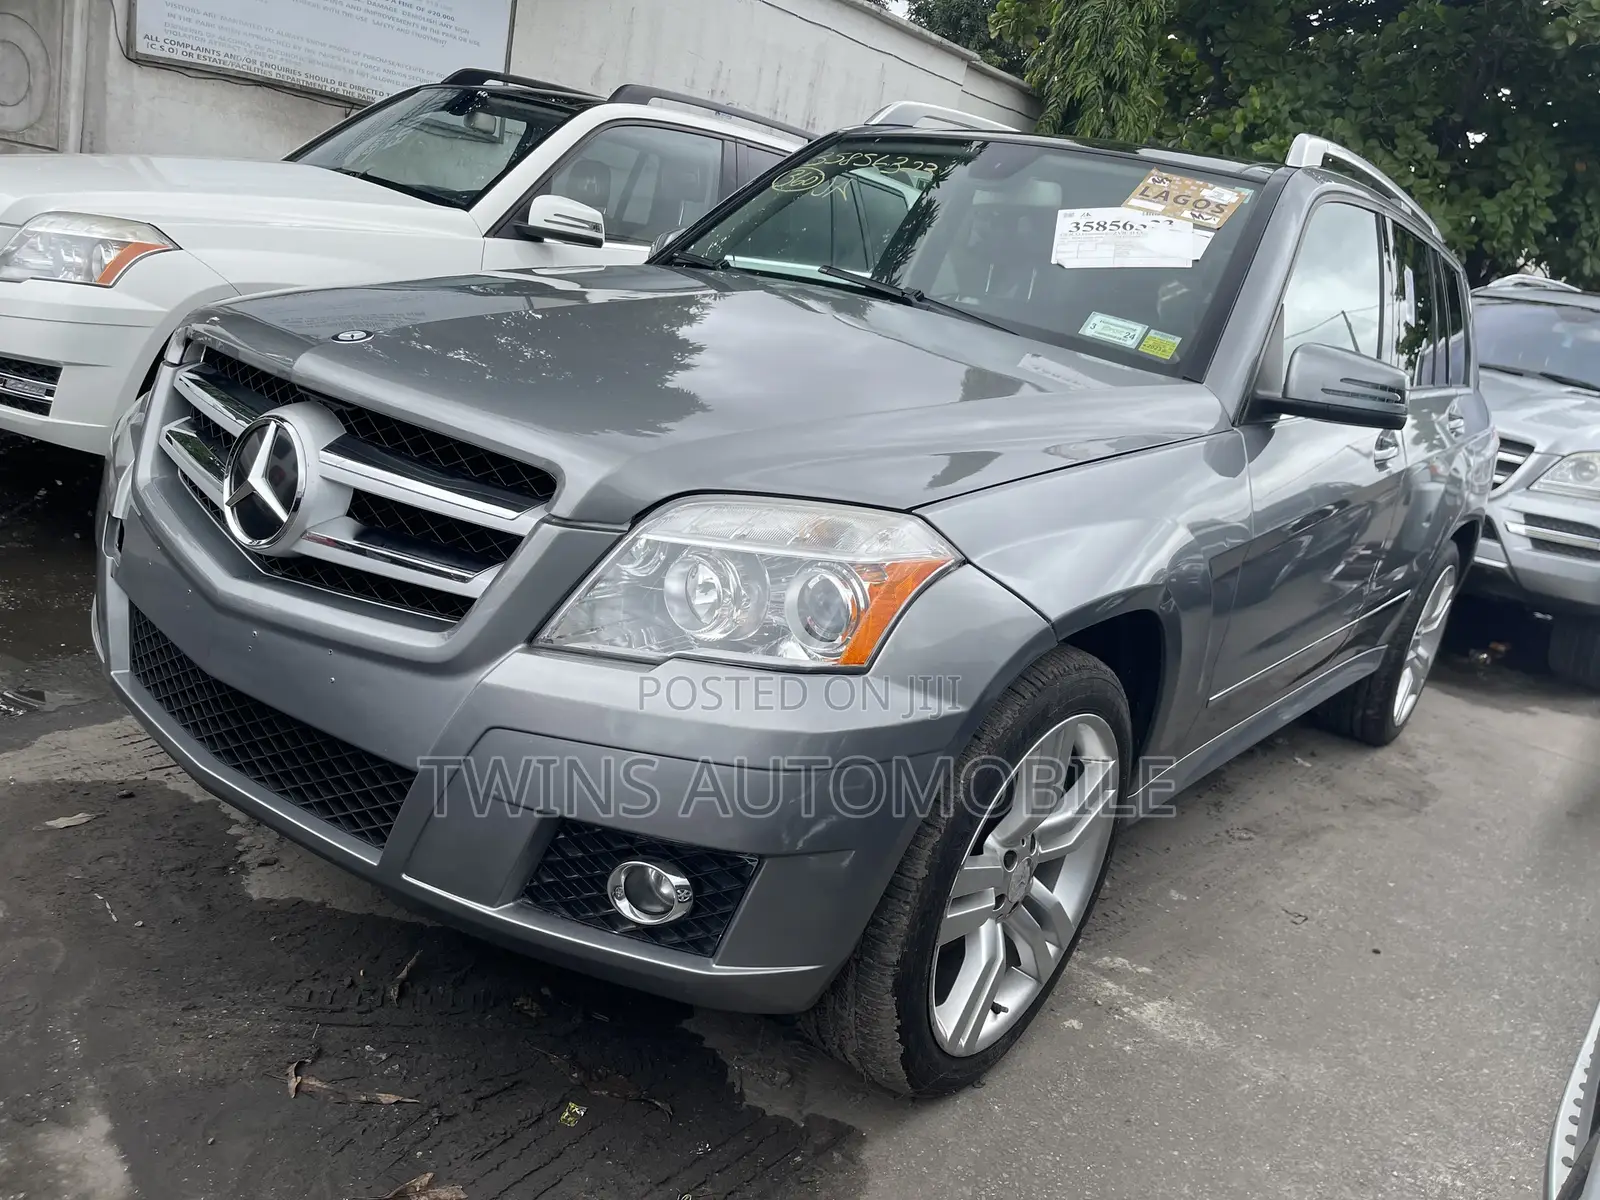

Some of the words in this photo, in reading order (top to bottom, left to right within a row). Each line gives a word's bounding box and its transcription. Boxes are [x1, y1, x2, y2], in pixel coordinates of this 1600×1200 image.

[438, 20, 453, 30] ANY
[143, 33, 161, 43] ALL
[163, 37, 221, 57] COMPLAINTS
[223, 50, 257, 65] AND/OR
[259, 61, 302, 77] ENQUIRIES
[304, 72, 336, 85] SHOULD
[337, 78, 348, 88] BE
[349, 83, 384, 97] DIRECTED
[181, 49, 194, 59] OR
[196, 53, 273, 76] ESTATE/FACILITIES
[275, 71, 328, 91] DEPARTMENT
[329, 85, 340, 94] OF
[341, 87, 355, 97] THE
[357, 91, 377, 103] PARK
[1139, 186, 1229, 215] LAGOS
